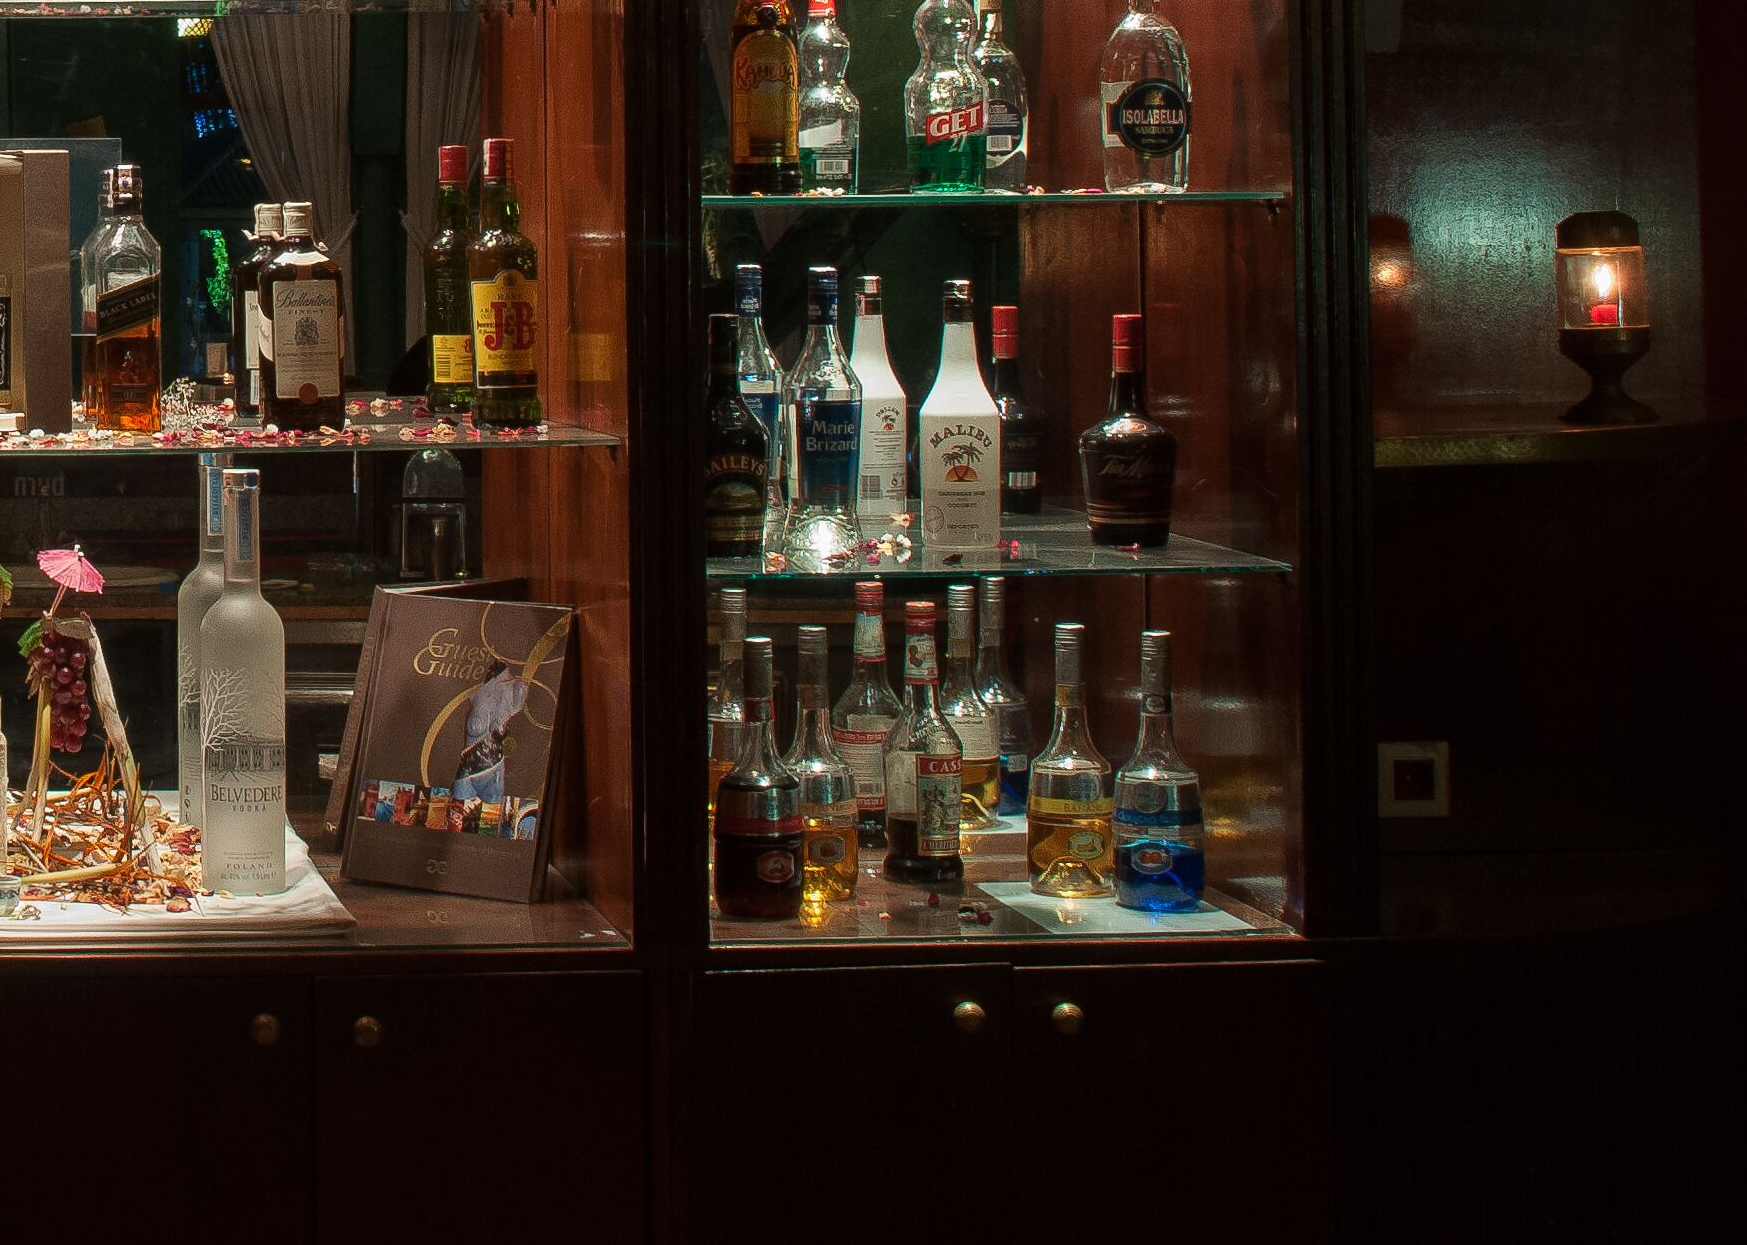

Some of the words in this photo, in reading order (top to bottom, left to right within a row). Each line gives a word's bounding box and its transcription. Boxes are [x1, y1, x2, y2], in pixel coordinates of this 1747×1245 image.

[929, 105, 981, 137] GET
[1122, 109, 1185, 125] ISOLABELLA
[99, 302, 128, 319] BLACK
[129, 291, 157, 308] LABEL
[812, 419, 855, 435] Marie
[929, 423, 994, 449] MALIBU
[805, 436, 859, 453] Brizard
[413, 646, 485, 681] Guide
[211, 783, 283, 803] BELVEDERE
[232, 804, 267, 812] VODKA
[226, 862, 273, 870] POLAND
